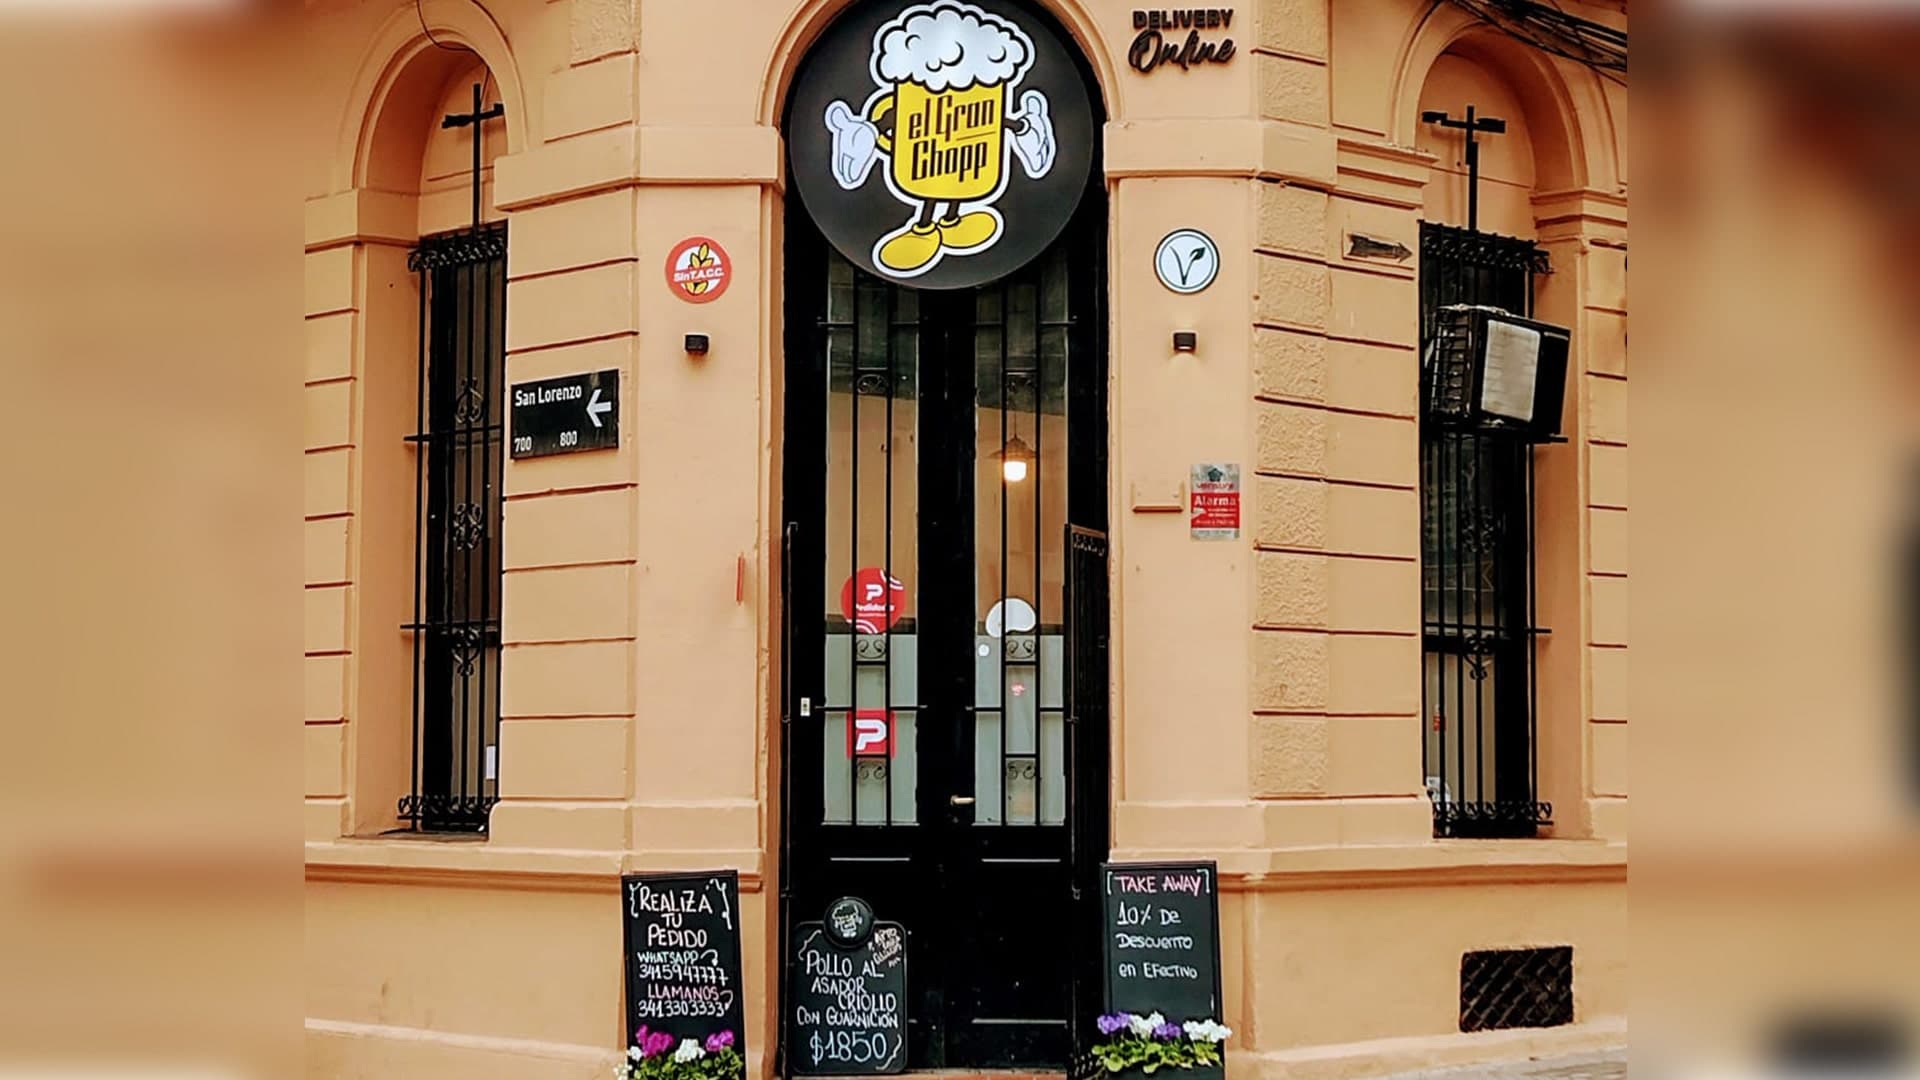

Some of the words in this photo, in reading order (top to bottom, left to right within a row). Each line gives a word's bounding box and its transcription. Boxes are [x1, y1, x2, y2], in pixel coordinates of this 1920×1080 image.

[1133, 9, 1234, 29] DELIVERY
[1128, 29, 1237, 73] Online
[908, 100, 931, 139] el
[937, 95, 995, 142] Gran
[911, 139, 988, 182] Chopp
[515, 390, 536, 407] San
[538, 385, 582, 404] Lorenzo
[514, 436, 532, 453] 700
[560, 430, 578, 447] 800
[1194, 495, 1237, 506] Alarma
[1114, 875, 1157, 893] TAKE
[1161, 875, 1202, 897] AWAY
[661, 912, 682, 929] TU
[1117, 901, 1152, 926] 10%
[647, 923, 708, 948] PEDIDO
[637, 951, 699, 966] WHATSAPP
[806, 950, 853, 977] POLLO
[862, 960, 885, 978] AL
[639, 964, 729, 986] 3415947777
[811, 975, 867, 996] ASADOR
[647, 983, 720, 1001] LLAMANOS
[838, 991, 897, 1013] CRIOLLO
[638, 999, 725, 1018] 3413303333
[809, 1030, 887, 1067] $1850
